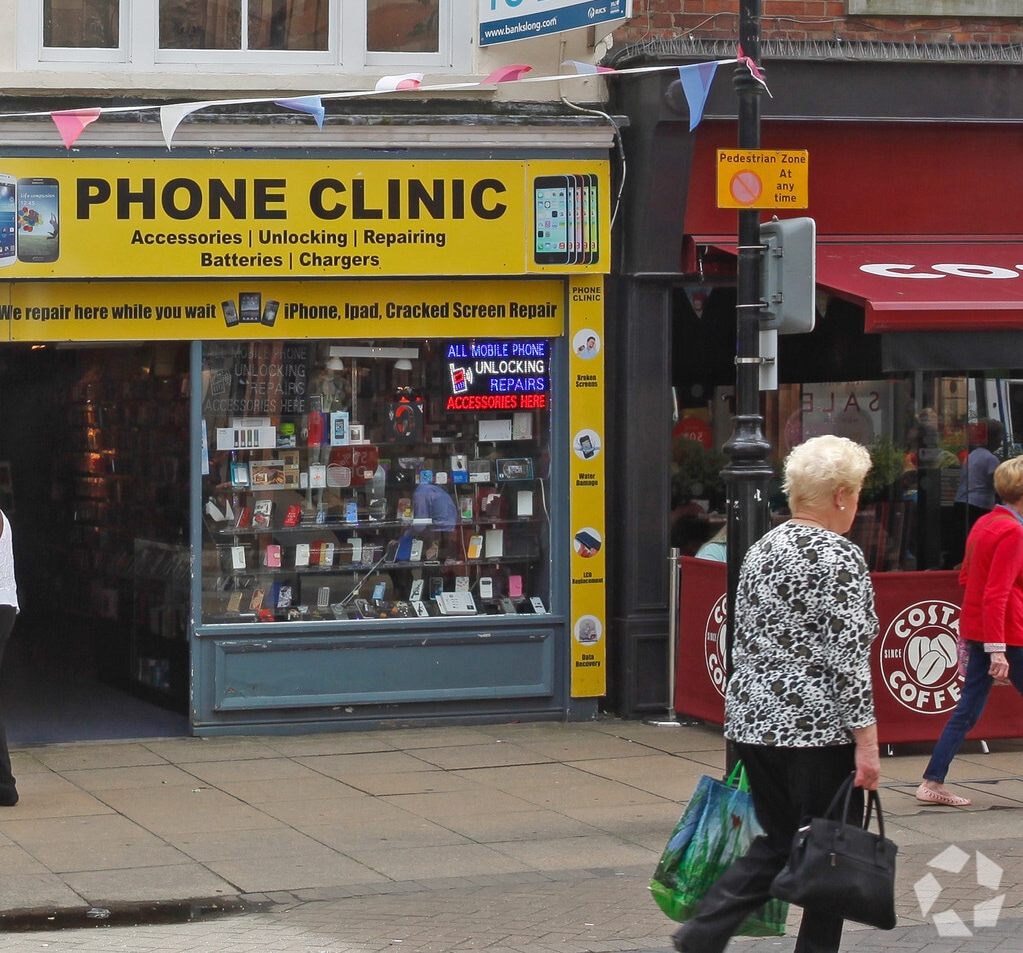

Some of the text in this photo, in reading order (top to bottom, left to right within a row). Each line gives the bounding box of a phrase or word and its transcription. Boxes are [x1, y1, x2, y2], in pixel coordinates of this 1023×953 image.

[484, 17, 557, 38] www.bankslong.com
[719, 154, 806, 163] Pedestrian Zone
[779, 169, 792, 178] At
[776, 183, 794, 192] any
[76, 178, 507, 220] PHONE CLINIC
[774, 194, 796, 202] time
[131, 230, 446, 247] Accessories Unlocking Repairing
[201, 253, 380, 269] Batteries Chargers
[572, 294, 601, 302] CLINIC
[26, 304, 71, 322] repair
[75, 304, 108, 320] here
[112, 304, 151, 320] while
[155, 307, 181, 321] you
[185, 304, 216, 319] wait
[284, 302, 341, 320] iPhone,
[386, 301, 449, 319] Cracked
[453, 301, 507, 318] Screen
[509, 301, 557, 319] Repair
[447, 343, 545, 357] ALL MOBILE PHONE
[234, 364, 305, 377] UNLOCKING
[475, 360, 544, 374] UNLOCKING
[490, 378, 544, 392] REPAIRS
[204, 399, 305, 413] ACCESSORIES HERE
[447, 395, 546, 410] ACCESSORIES HERE
[884, 649, 902, 659] SINCE
[890, 670, 966, 709] COFFE
